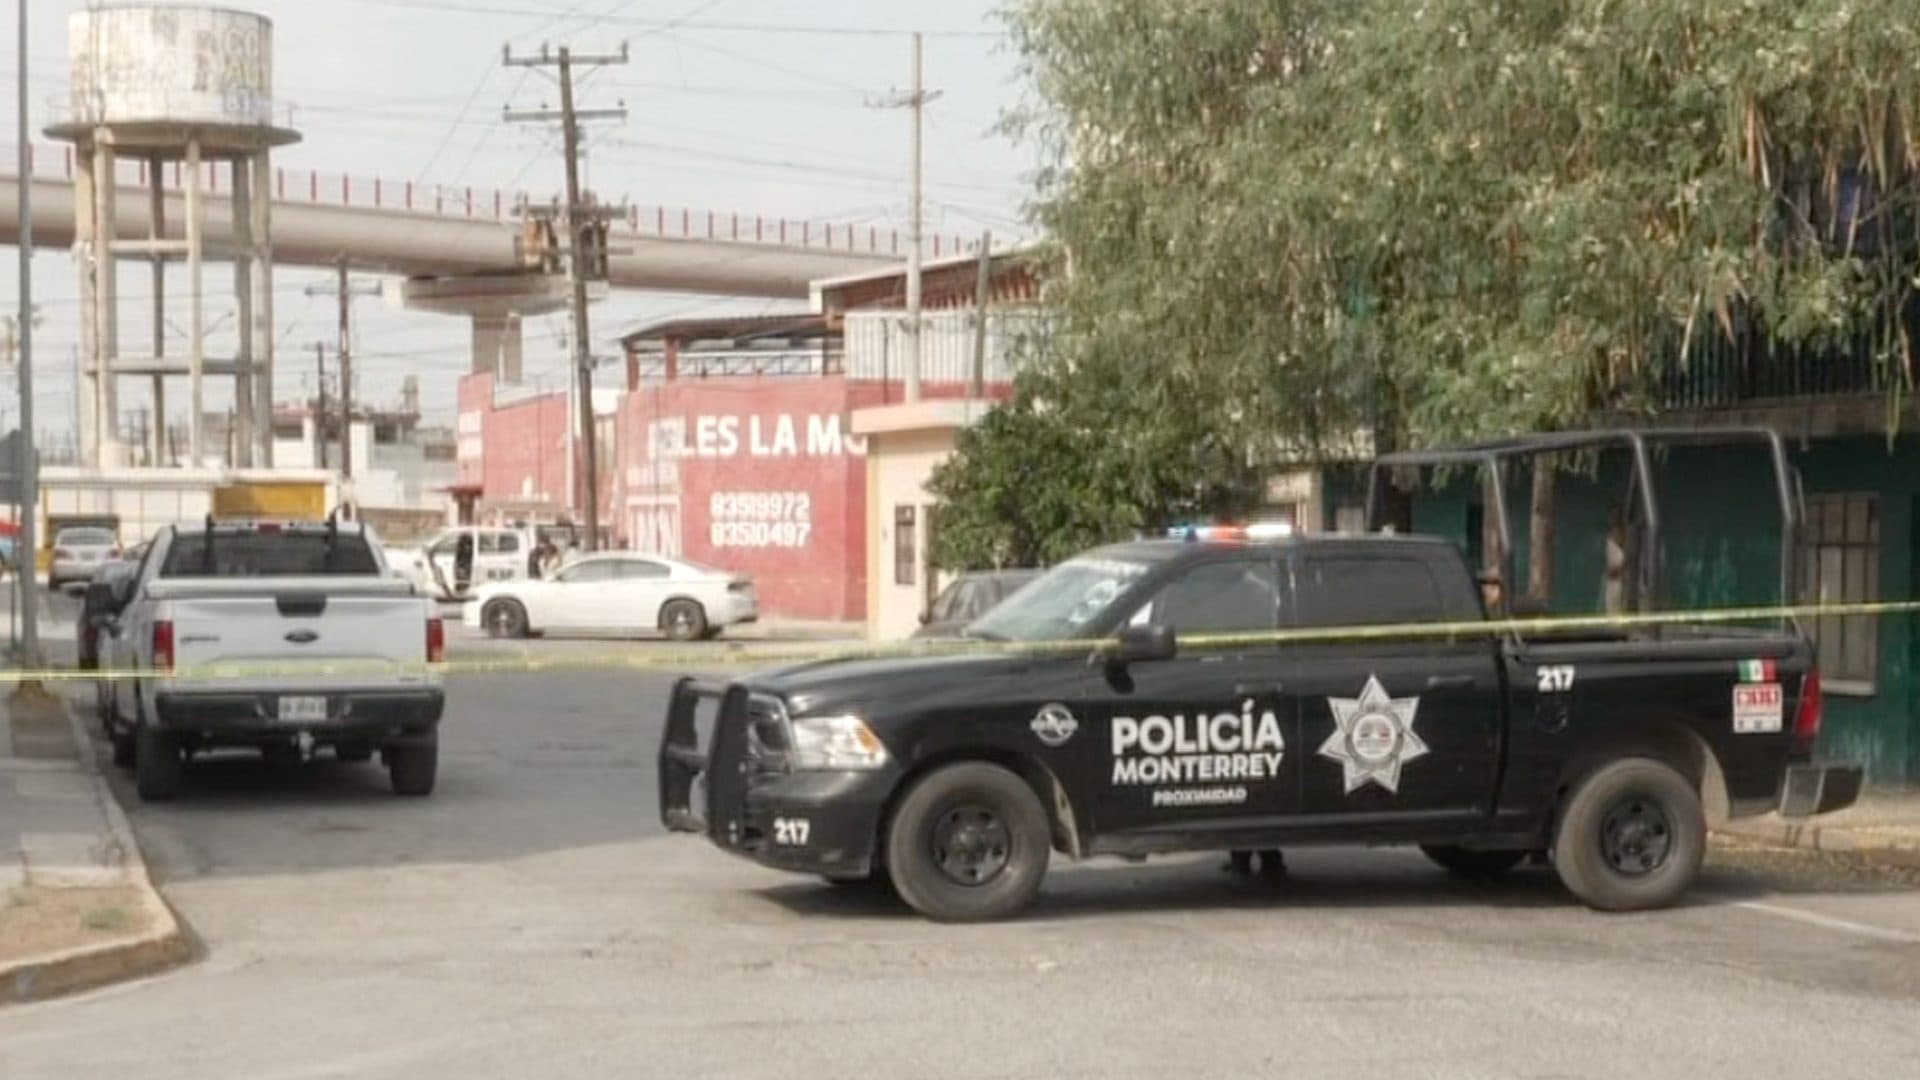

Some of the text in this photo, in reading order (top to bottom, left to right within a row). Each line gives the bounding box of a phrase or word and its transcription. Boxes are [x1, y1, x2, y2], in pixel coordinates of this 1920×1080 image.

[749, 413, 797, 455] LA
[1537, 664, 1575, 691] 217
[1111, 699, 1285, 756] POLICÍA
[1112, 752, 1283, 785] MONTERREY
[1153, 787, 1247, 806] PROXIMIDAD
[773, 817, 810, 845] 217
